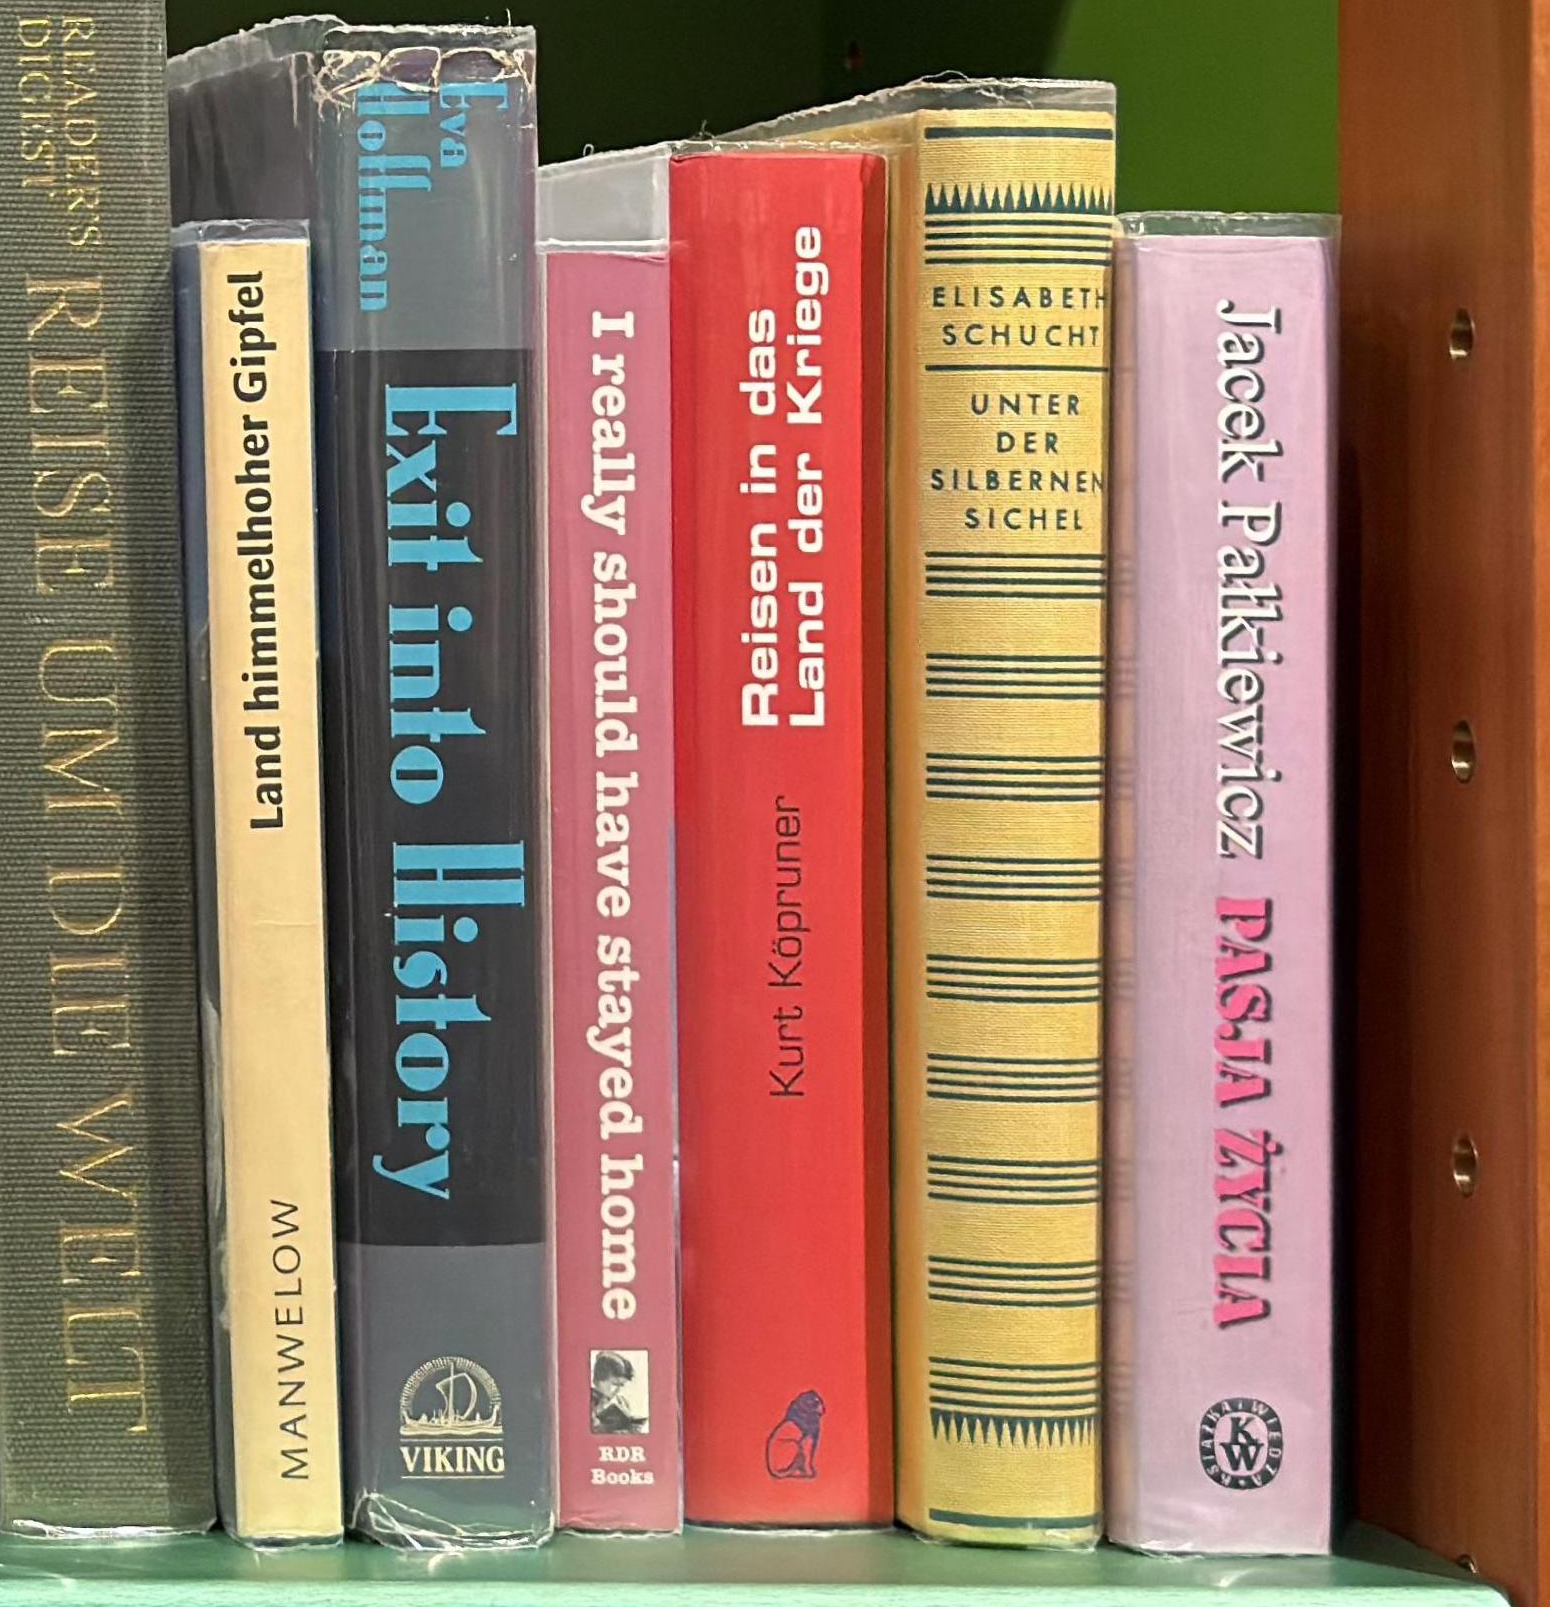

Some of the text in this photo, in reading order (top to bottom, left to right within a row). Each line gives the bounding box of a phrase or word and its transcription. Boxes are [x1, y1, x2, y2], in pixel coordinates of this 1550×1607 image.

[16, 17, 57, 195] DIGEST
[439, 82, 509, 168] Eva
[357, 82, 433, 313] Hoffman
[932, 286, 1108, 309] ELISABETH
[942, 324, 1099, 346] SCHUCHT
[786, 225, 830, 728] Land der Kriege
[931, 468, 1104, 493] SILBERNEN
[970, 393, 1080, 415] UNTER
[996, 431, 1059, 454] DER
[1216, 298, 1284, 484] Jacek
[229, 271, 285, 830] Land himmelhoher Gipfel
[739, 308, 779, 728] Reisen in das
[964, 507, 1083, 530] SICHEL
[25, 276, 150, 1435] REISE UM DIE WELT
[373, 383, 526, 1201] Exit into History
[580, 310, 644, 1321] I really should have stayed home
[768, 795, 812, 1099] Kurt Köpruner
[1211, 897, 1284, 1330] PASJA ŻYCIA
[270, 1198, 311, 1482] MANWELOW
[400, 1444, 506, 1475] VIKING
[590, 1467, 654, 1486] Books
[599, 1445, 646, 1463] RDR
